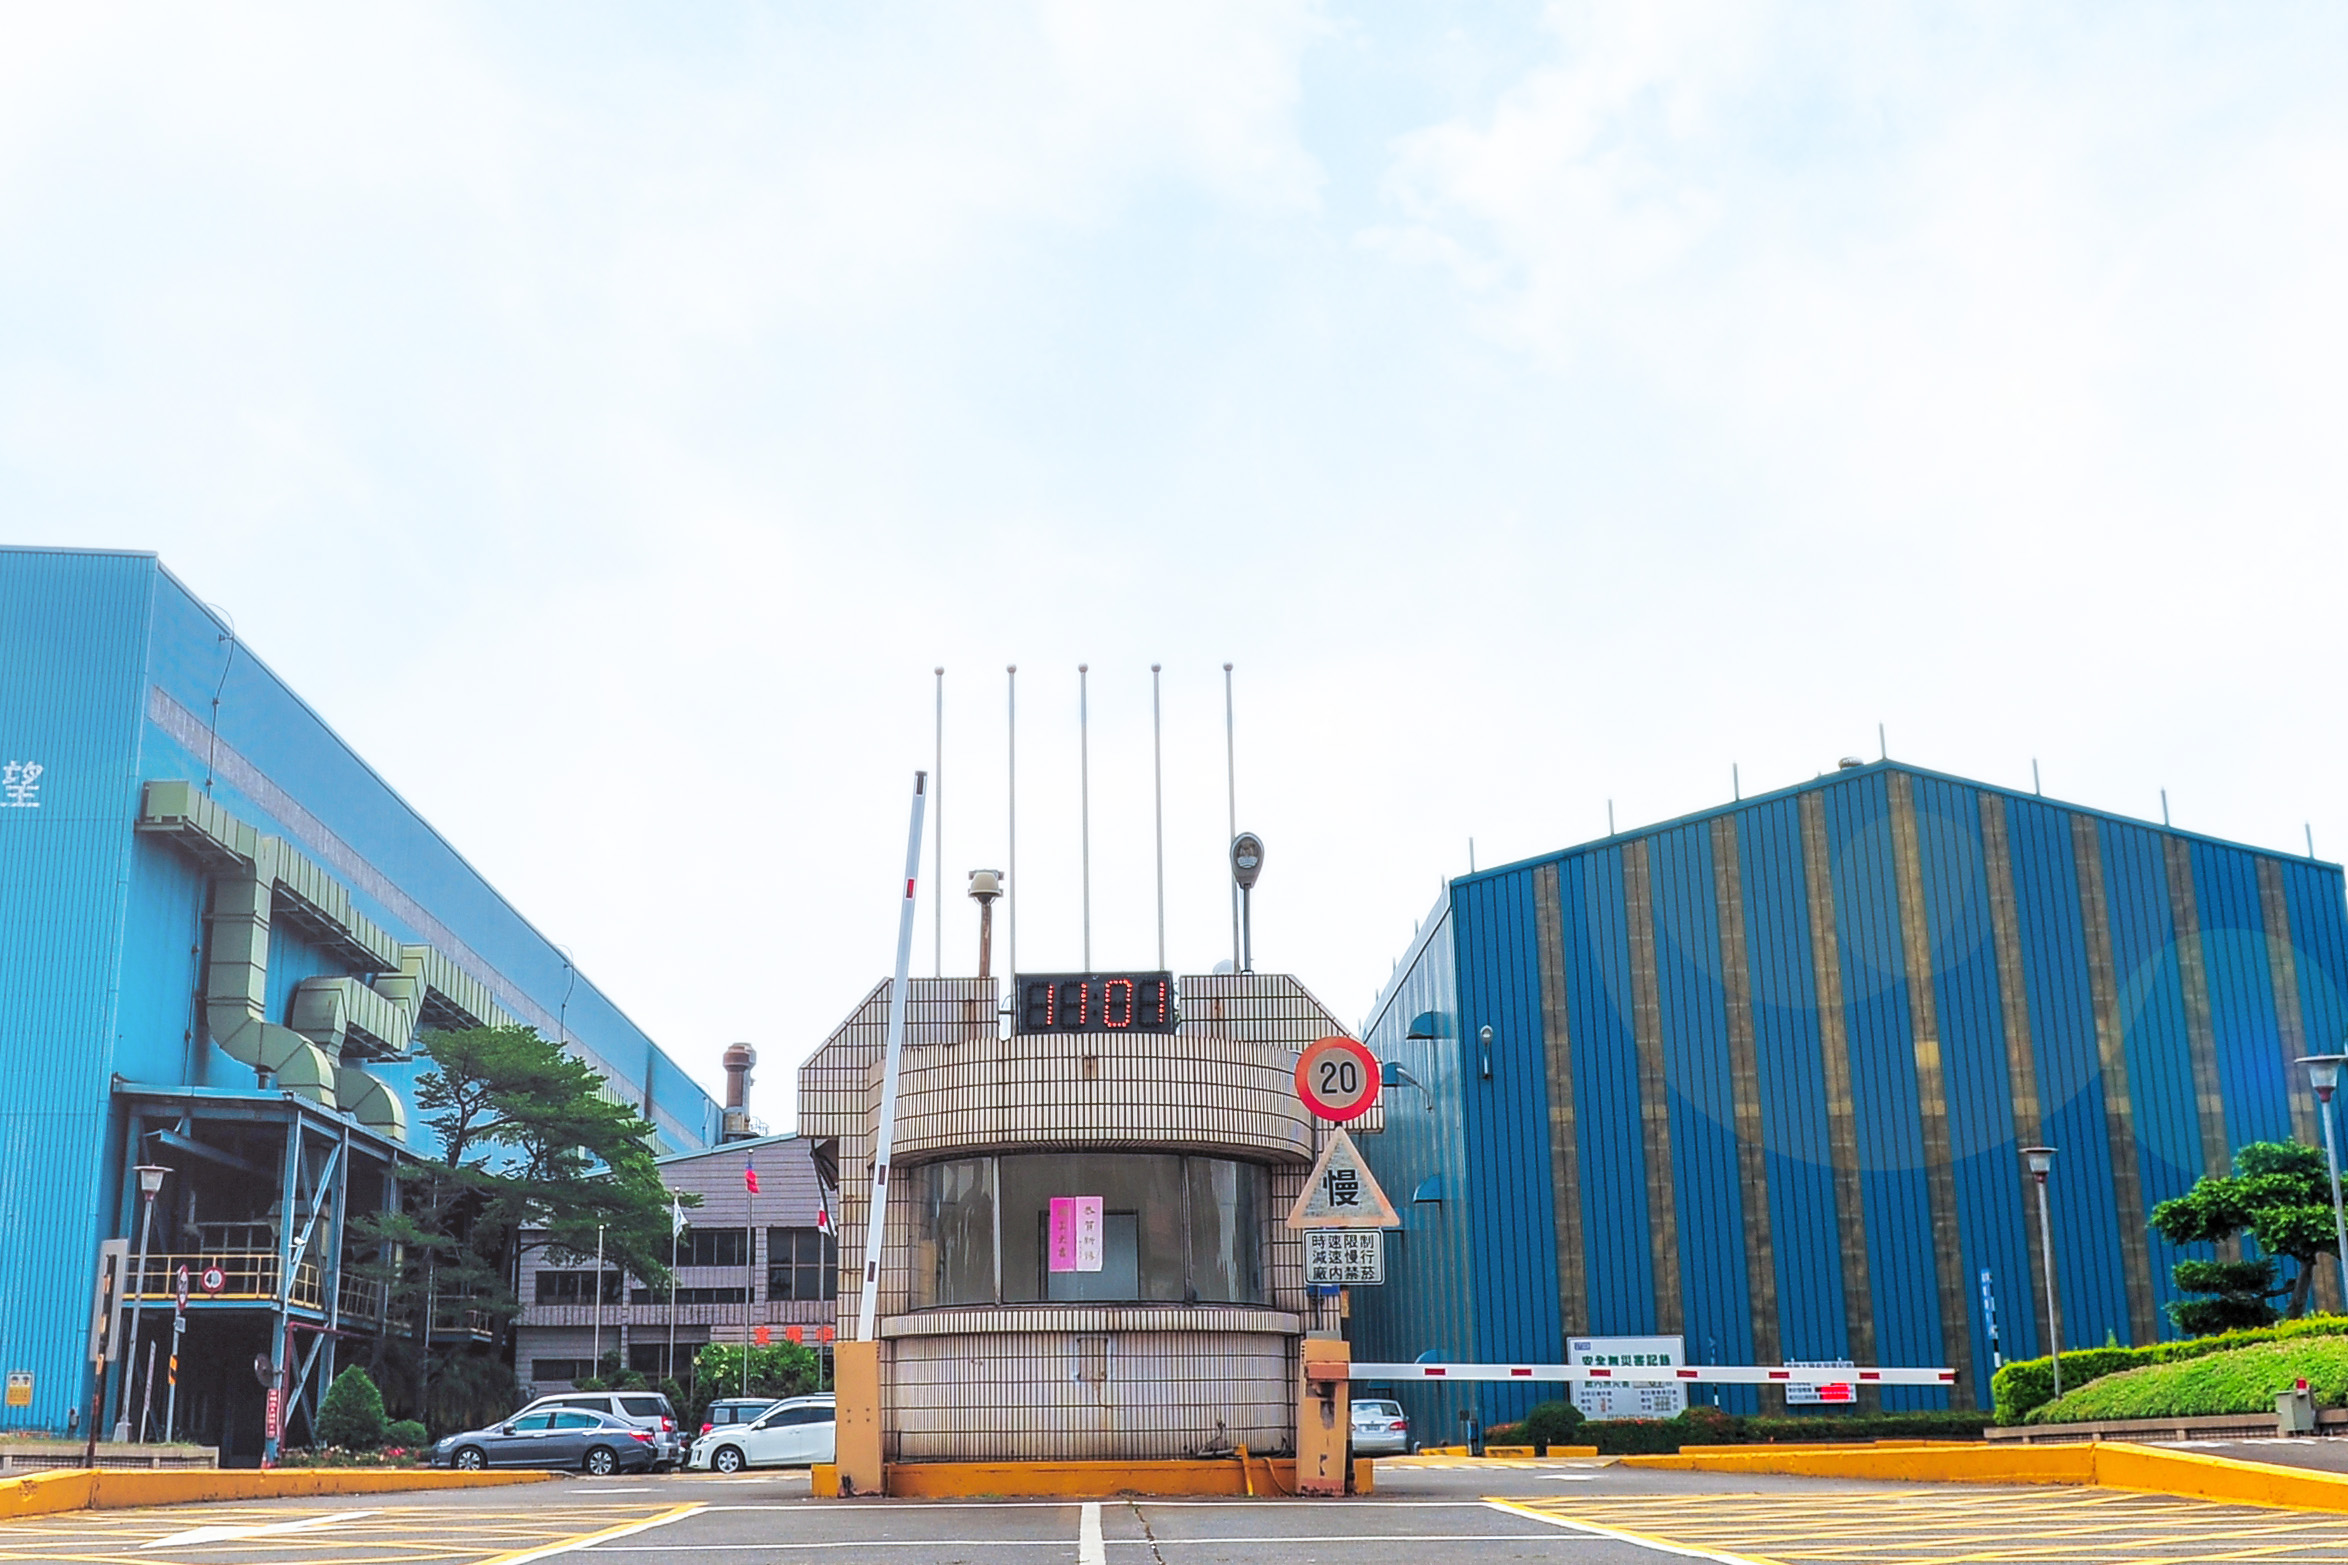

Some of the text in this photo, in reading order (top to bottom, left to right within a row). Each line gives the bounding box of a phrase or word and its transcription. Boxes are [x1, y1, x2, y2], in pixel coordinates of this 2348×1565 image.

[0, 761, 44, 807] 望
[1320, 1061, 1357, 1094] 20
[1322, 1169, 1359, 1207] 慢
[1312, 1234, 1374, 1249] 時速限制
[1312, 1250, 1375, 1264] 減速慢行
